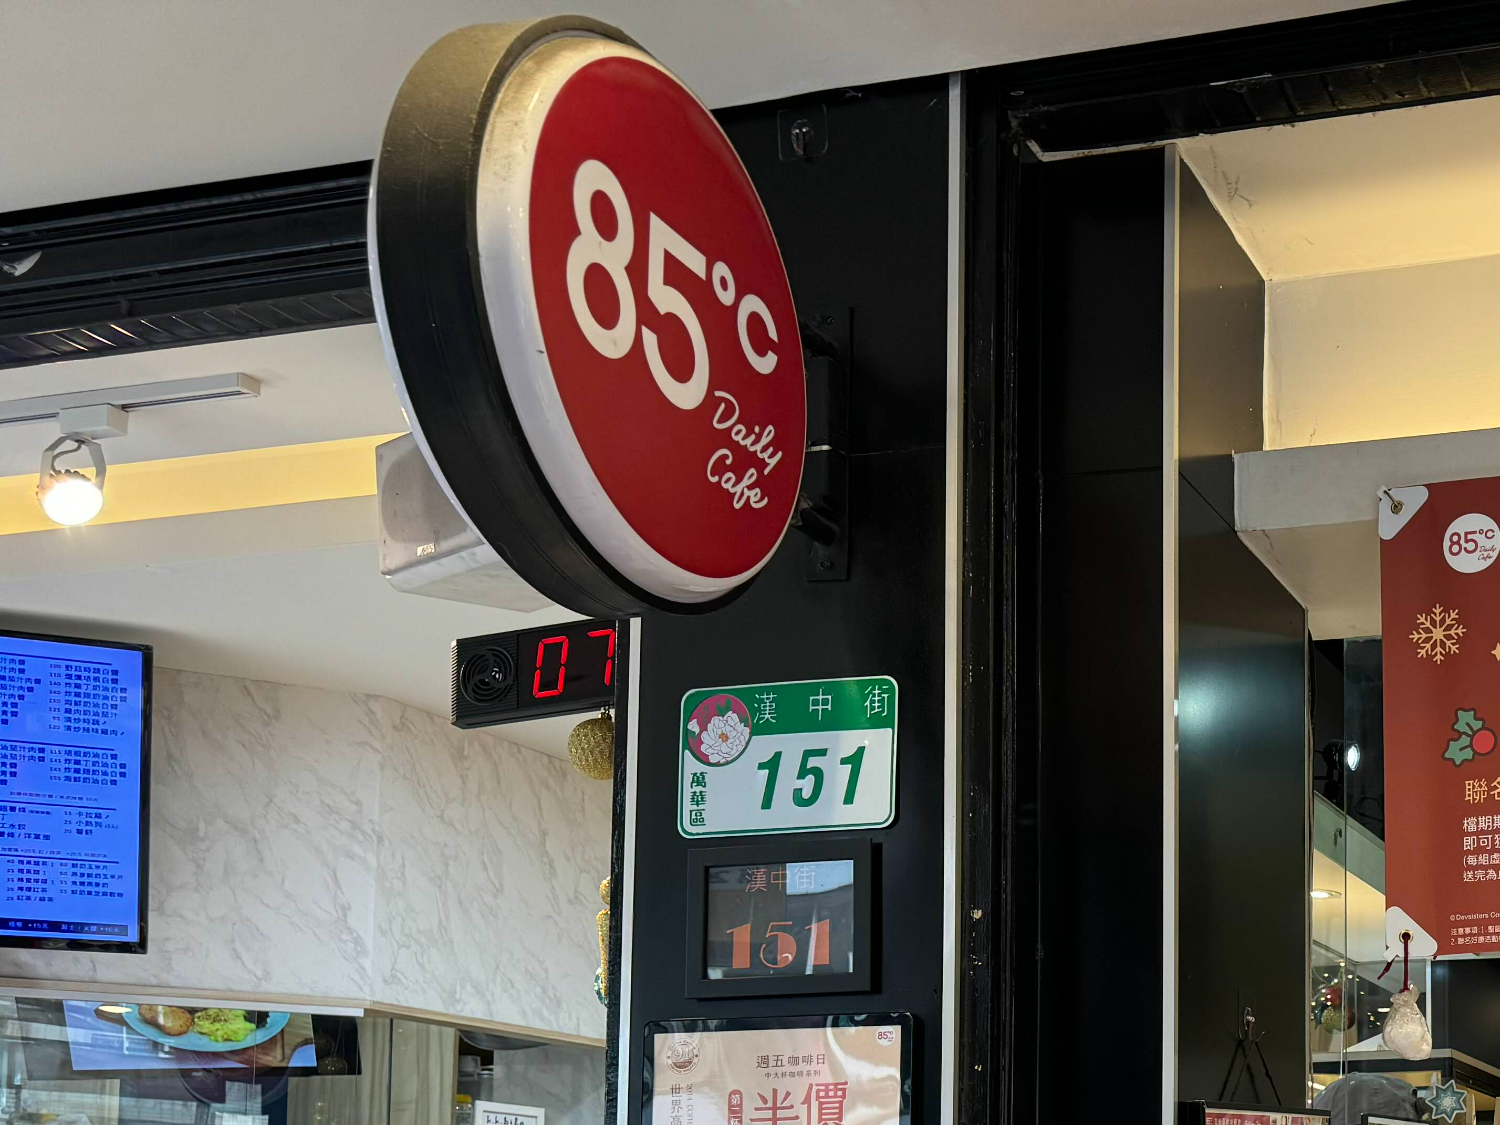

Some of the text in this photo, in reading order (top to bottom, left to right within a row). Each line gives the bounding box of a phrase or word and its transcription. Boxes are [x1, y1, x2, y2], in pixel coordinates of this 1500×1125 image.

[714, 391, 782, 474] Daily
[706, 448, 768, 509] Cafe
[753, 686, 889, 724] 漢中街
[690, 772, 708, 827] 萬華區
[756, 745, 866, 810] 151
[744, 865, 816, 893] 漢中街
[726, 918, 830, 969] 151
[756, 1054, 826, 1069] 週五咖啡日
